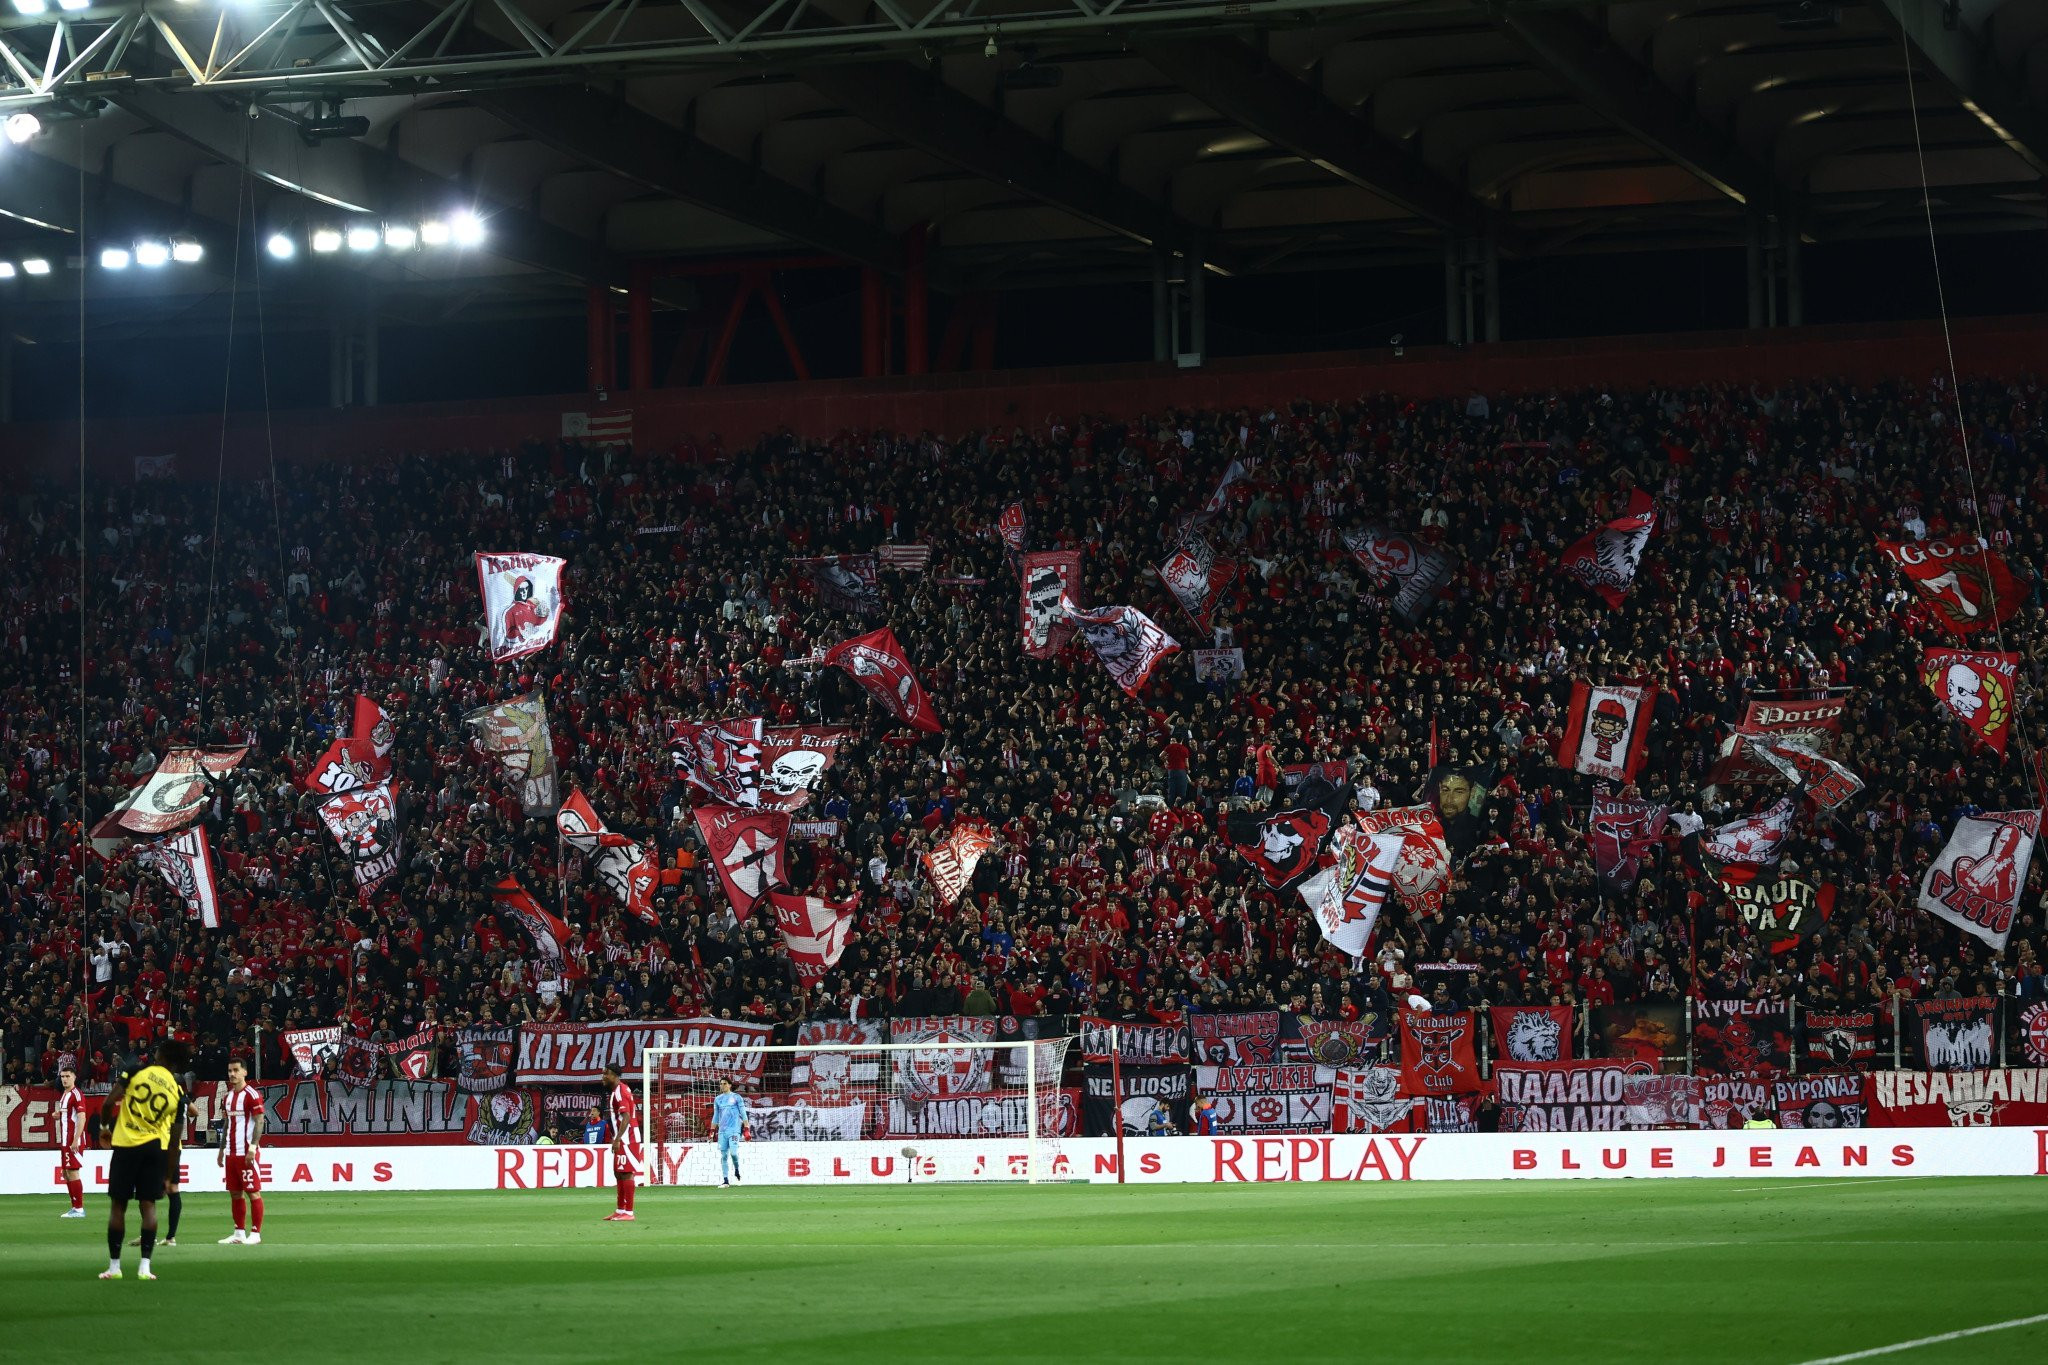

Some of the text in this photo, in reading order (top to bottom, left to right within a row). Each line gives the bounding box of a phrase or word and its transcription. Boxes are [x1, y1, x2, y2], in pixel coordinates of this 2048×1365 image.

[1753, 706, 1842, 726] Porto
[1696, 999, 1785, 1019] ΚΥΨΕΛΗ
[891, 1016, 996, 1036] MISFITS
[517, 1028, 767, 1071] ΧΑΤΖΗΚΥΡΙΑΚΕΙΟ
[1130, 1074, 1187, 1095] LIOSIA
[1216, 1065, 1317, 1092] ΔΥΤΙΚΗ
[1424, 1074, 1453, 1087] Club
[1498, 1069, 1624, 1103] ΠΑΛΑΙΟ
[1775, 1076, 1861, 1102] ΒΥΡΩΝΑΣ
[1876, 1067, 2048, 1108] KESARIANI
[129, 1083, 169, 1124] 29
[1704, 1082, 1766, 1102] ΒΟΥΛΑ
[889, 1096, 1037, 1134] ΜΕΤΑΜΟΡΦΩΣ
[65, 1153, 70, 1162] 5
[617, 1154, 627, 1164] 70
[1212, 1137, 1427, 1182] REPLAY
[1513, 1144, 1915, 1170] BLUE JEANS
[241, 1169, 253, 1182] 22
